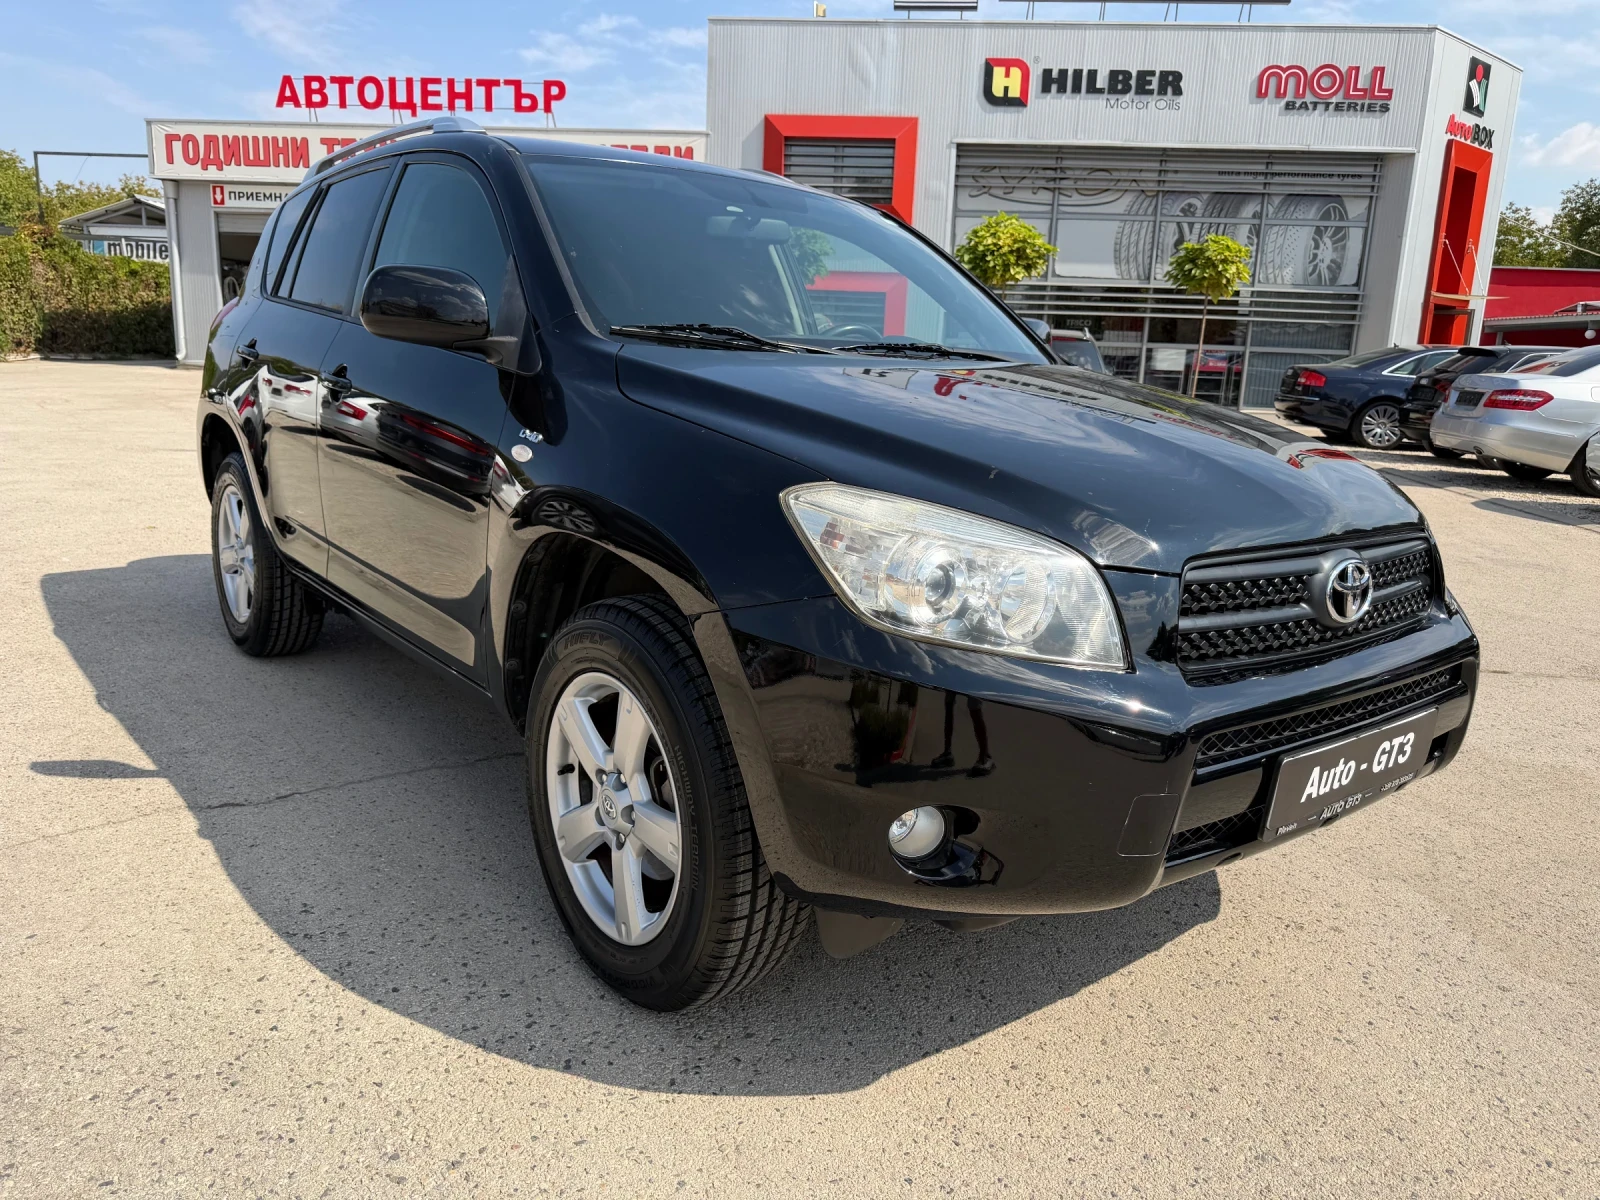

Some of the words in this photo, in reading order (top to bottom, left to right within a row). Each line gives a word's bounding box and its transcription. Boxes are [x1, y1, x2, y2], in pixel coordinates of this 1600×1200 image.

[1041, 68, 1184, 96] HILBER
[276, 75, 566, 117] АВТОЦЕНТЪР
[1105, 98, 1150, 110] Motor
[1155, 98, 1181, 111] Oils
[1284, 100, 1391, 113] BATTERIES
[165, 133, 310, 171] ГОДИШНИ
[228, 190, 288, 202] ПРИЕМН
[107, 241, 168, 260] mobile
[1300, 757, 1356, 803] Auto
[1371, 732, 1415, 774] GT3
